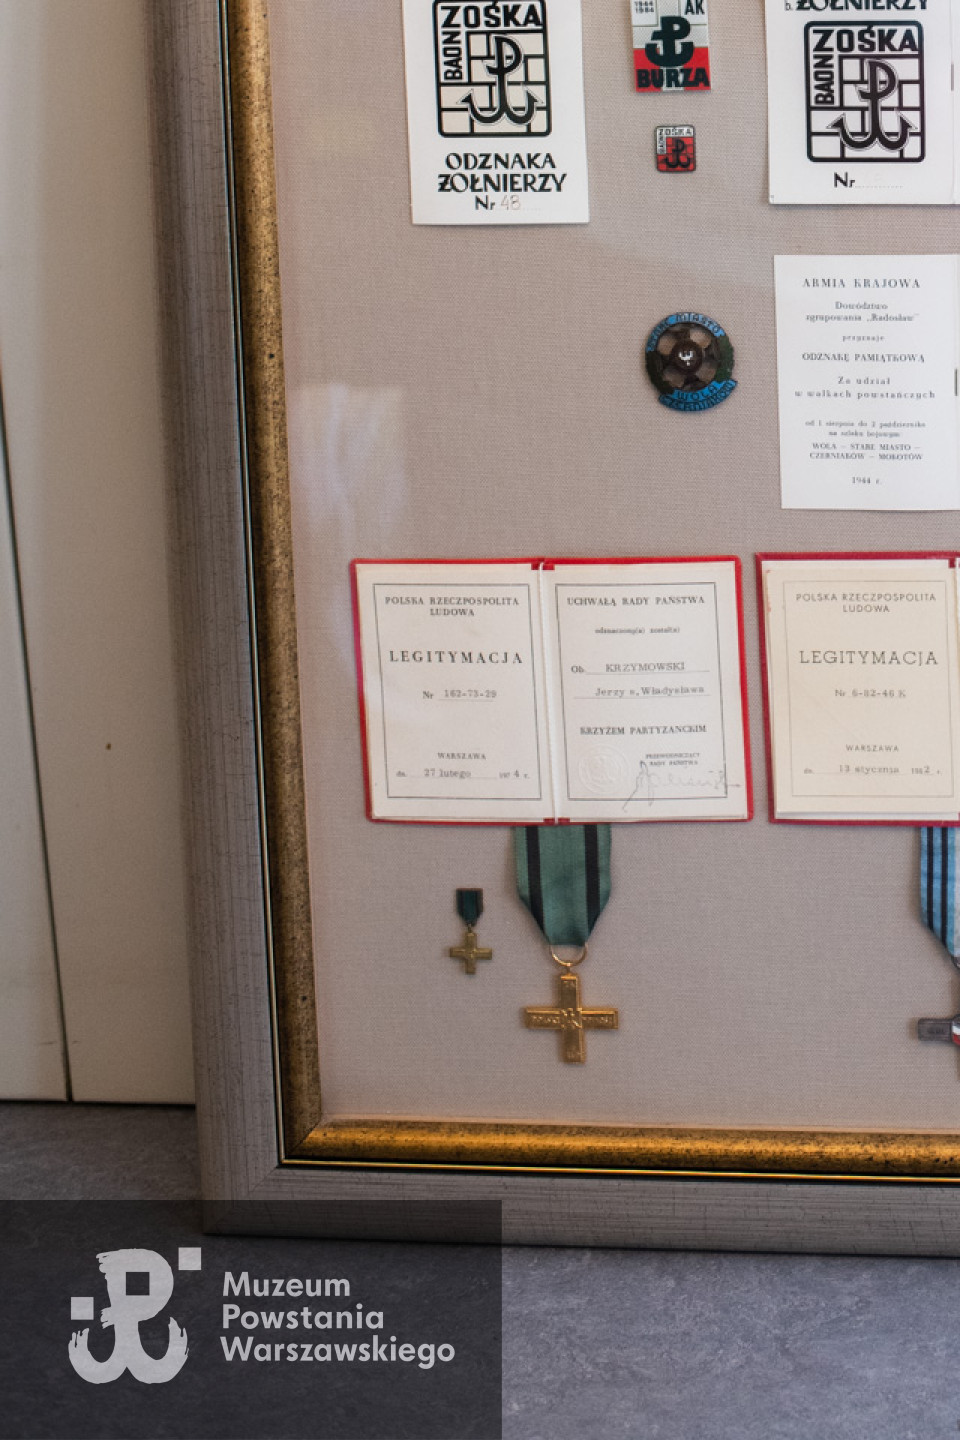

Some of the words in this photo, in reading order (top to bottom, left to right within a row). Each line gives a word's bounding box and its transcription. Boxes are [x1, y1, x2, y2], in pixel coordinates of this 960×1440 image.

[440, 2, 544, 28] ZOŚKA
[812, 24, 919, 53] ZOŚKA
[442, 30, 463, 81] BAON
[637, 68, 711, 89] BURZA
[813, 54, 834, 106] BAON
[445, 152, 557, 170] ODZNAKA
[438, 173, 567, 193] ŻOŁNIERZY
[834, 172, 855, 188] Nr
[474, 195, 496, 211] Nr
[802, 278, 846, 289] ARMIA
[854, 278, 921, 289] KRAJOWA
[806, 313, 862, 324] zgrupowania
[842, 334, 885, 343] przyznaje
[802, 352, 850, 363] ODZNAKĘ
[854, 353, 926, 364] PAMIĄTKOWĄ
[856, 376, 891, 385] udział
[807, 390, 852, 398] walkach
[857, 390, 936, 401] powstańczych
[851, 475, 872, 484] 1944
[384, 596, 424, 605] POLSKA
[429, 596, 519, 606] RZECZPOSPOLITA
[567, 597, 617, 607] UCHWAŁĄ
[622, 596, 649, 606] RADY
[655, 595, 705, 606] PAŃSTWA
[796, 593, 838, 602] POLSKA
[842, 593, 937, 602] RZECZPOSPOLITA
[430, 608, 475, 617] LUDOWA
[842, 604, 891, 613] LUDOWA
[389, 650, 523, 664] LEGITYMACJA
[799, 650, 938, 666] LEGITYMACJA
[605, 662, 685, 672] KRZYMOWSKI
[422, 690, 434, 700] Nr
[595, 686, 625, 698] Jerzy
[834, 689, 846, 697] Nr
[580, 725, 625, 736] KRZYŻEM
[630, 724, 707, 736] PARTYZANCKIM
[845, 744, 900, 753] WARSZAWA
[437, 752, 487, 761] WARSZAWA
[424, 768, 436, 777] 27
[439, 768, 471, 780] lutego
[854, 764, 900, 775] stycznia
